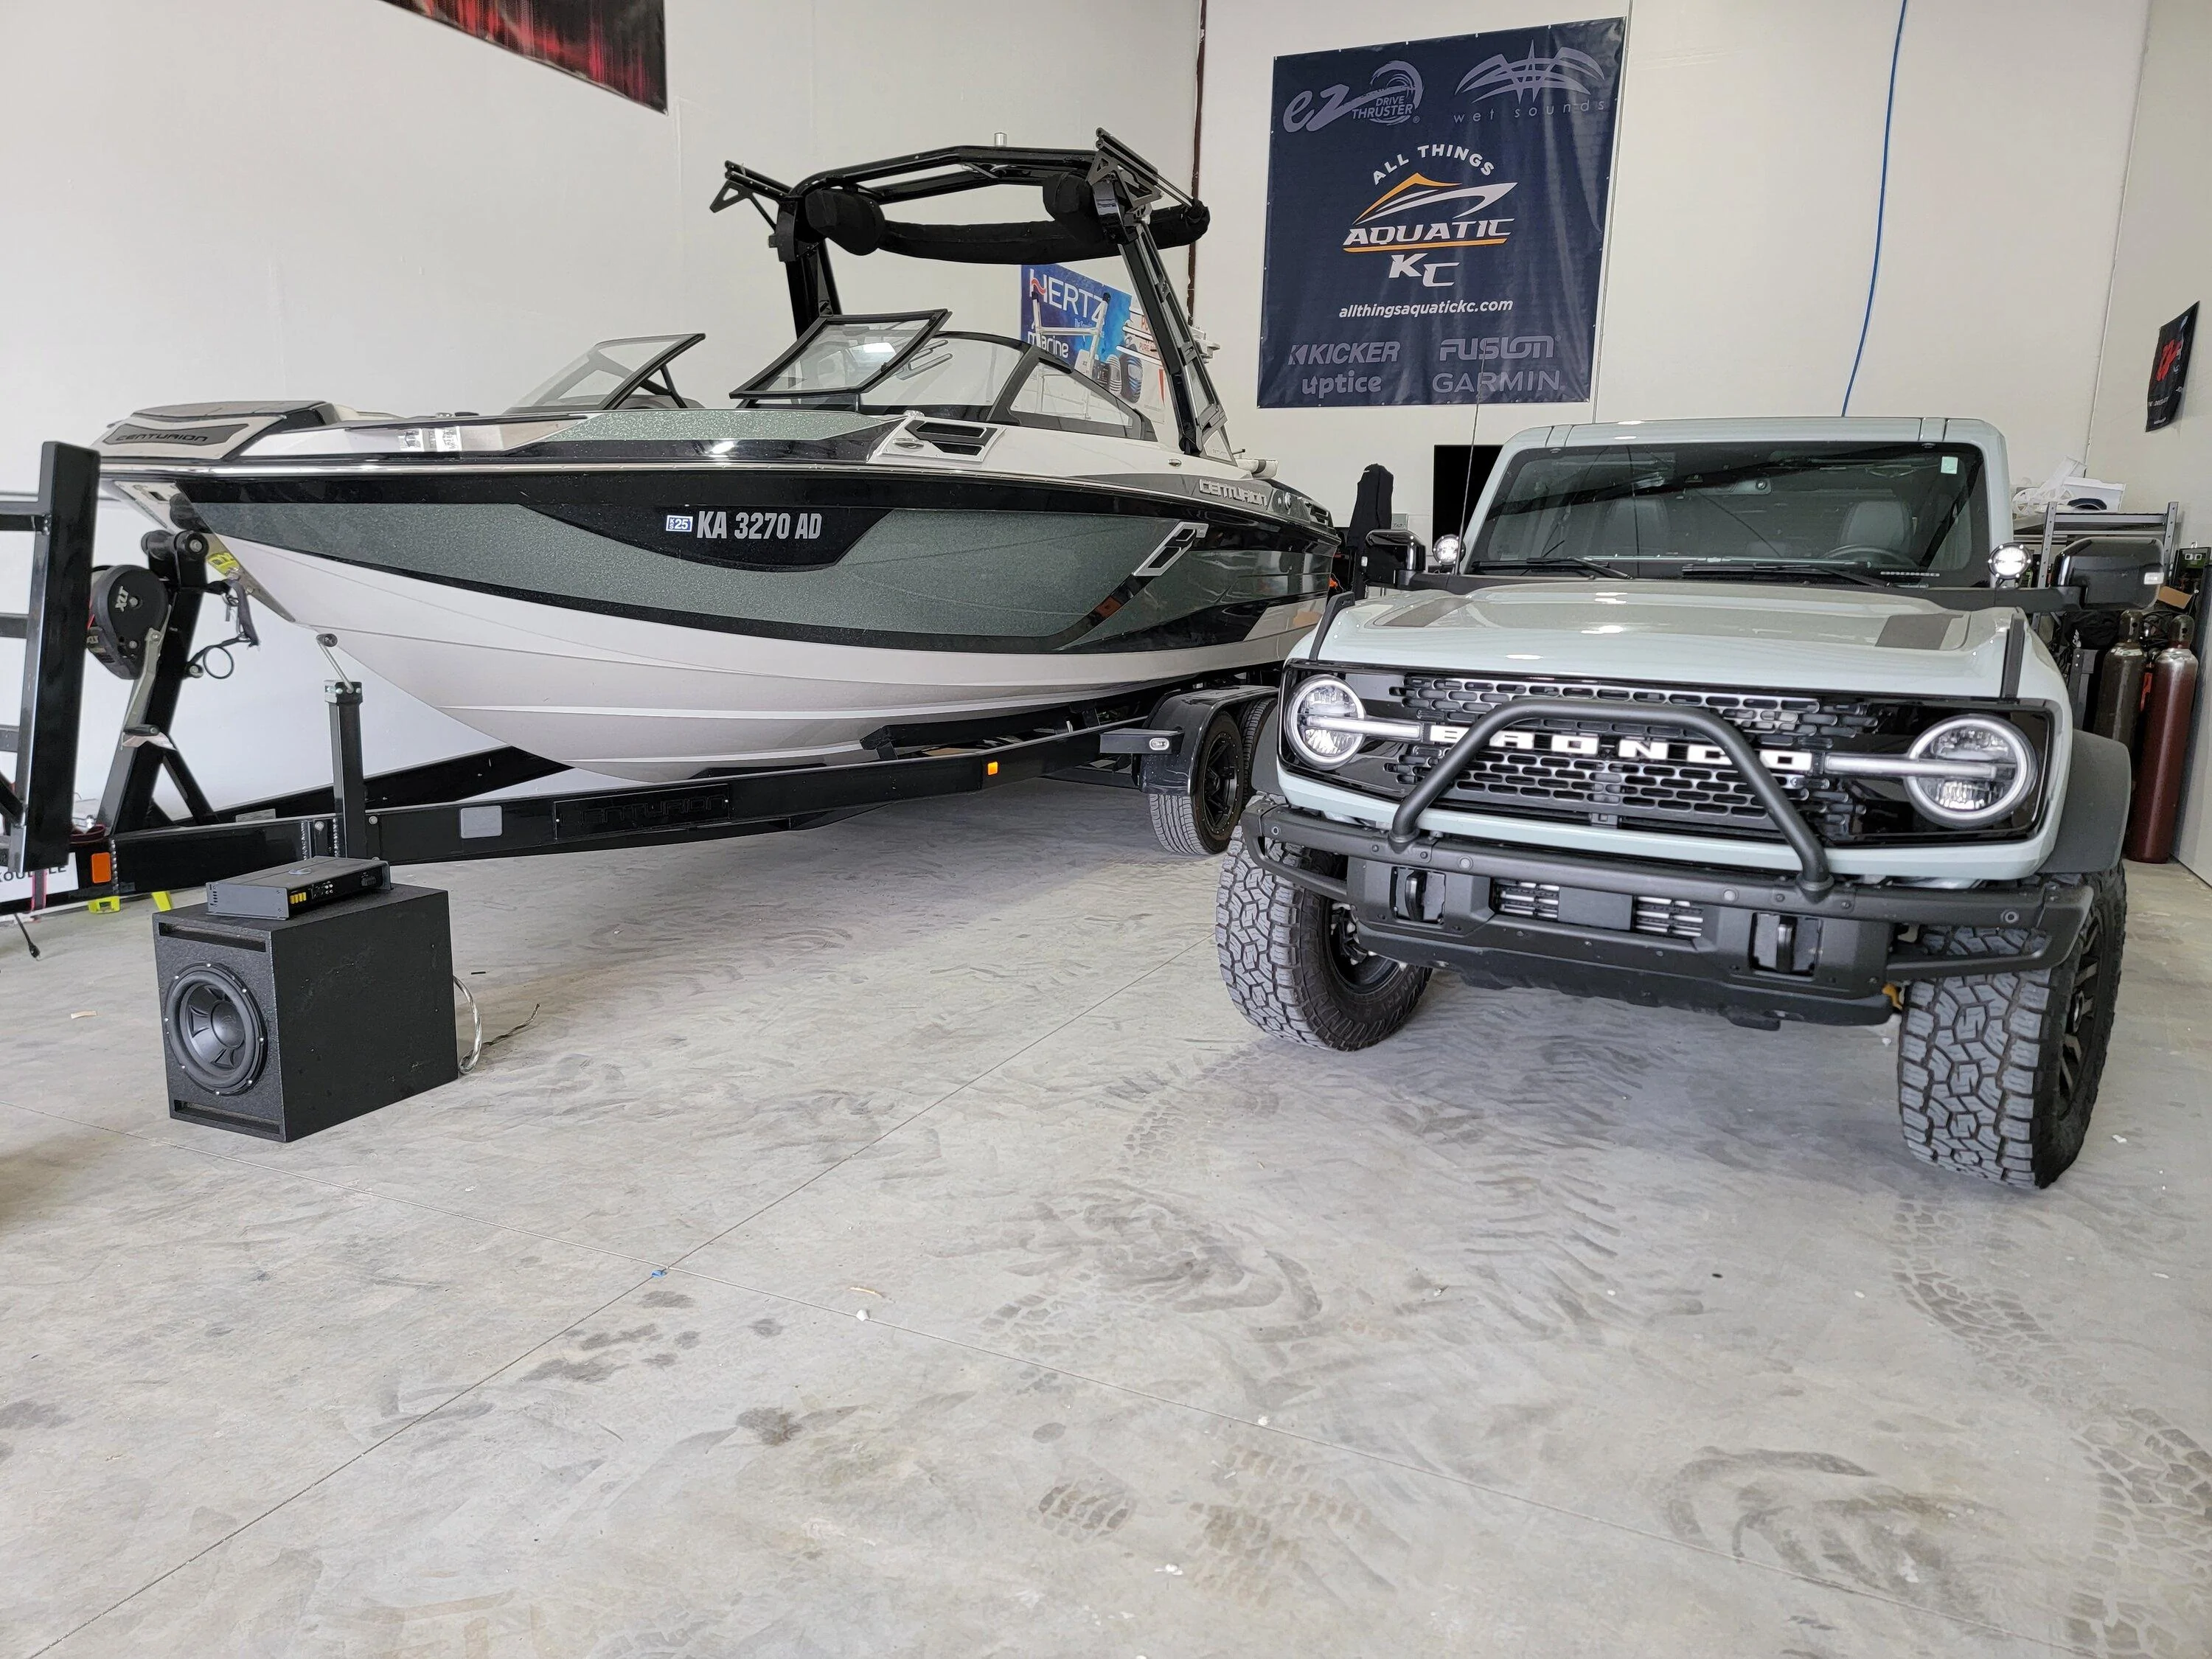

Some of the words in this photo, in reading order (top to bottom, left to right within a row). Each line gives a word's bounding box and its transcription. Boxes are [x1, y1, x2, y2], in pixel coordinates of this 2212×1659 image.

[1352, 103, 1413, 119] THRUSTER
[1375, 95, 1405, 107] DRIVE
[1453, 108, 1495, 124] wet
[1514, 100, 1605, 119] sounds
[1372, 153, 1409, 186] ALL
[1417, 144, 1495, 176] THINGS
[1343, 218, 1515, 246] AQUATIC
[1388, 253, 1460, 288] KC
[1029, 268, 1106, 325] HERTZ
[1339, 298, 1514, 319] allthingsaquatickc.com
[1306, 340, 1401, 366] KICKER
[1439, 335, 1554, 362] FUSION
[1301, 369, 1382, 399] uptice
[1432, 370, 1561, 394] GARMIN
[115, 433, 209, 442] CENTURION
[1200, 479, 1268, 507] CENTURION
[675, 518, 689, 530] 25
[697, 511, 728, 539] KA
[734, 512, 791, 540] 3270
[794, 513, 823, 540] AD
[1430, 725, 1813, 772] BRONCO
